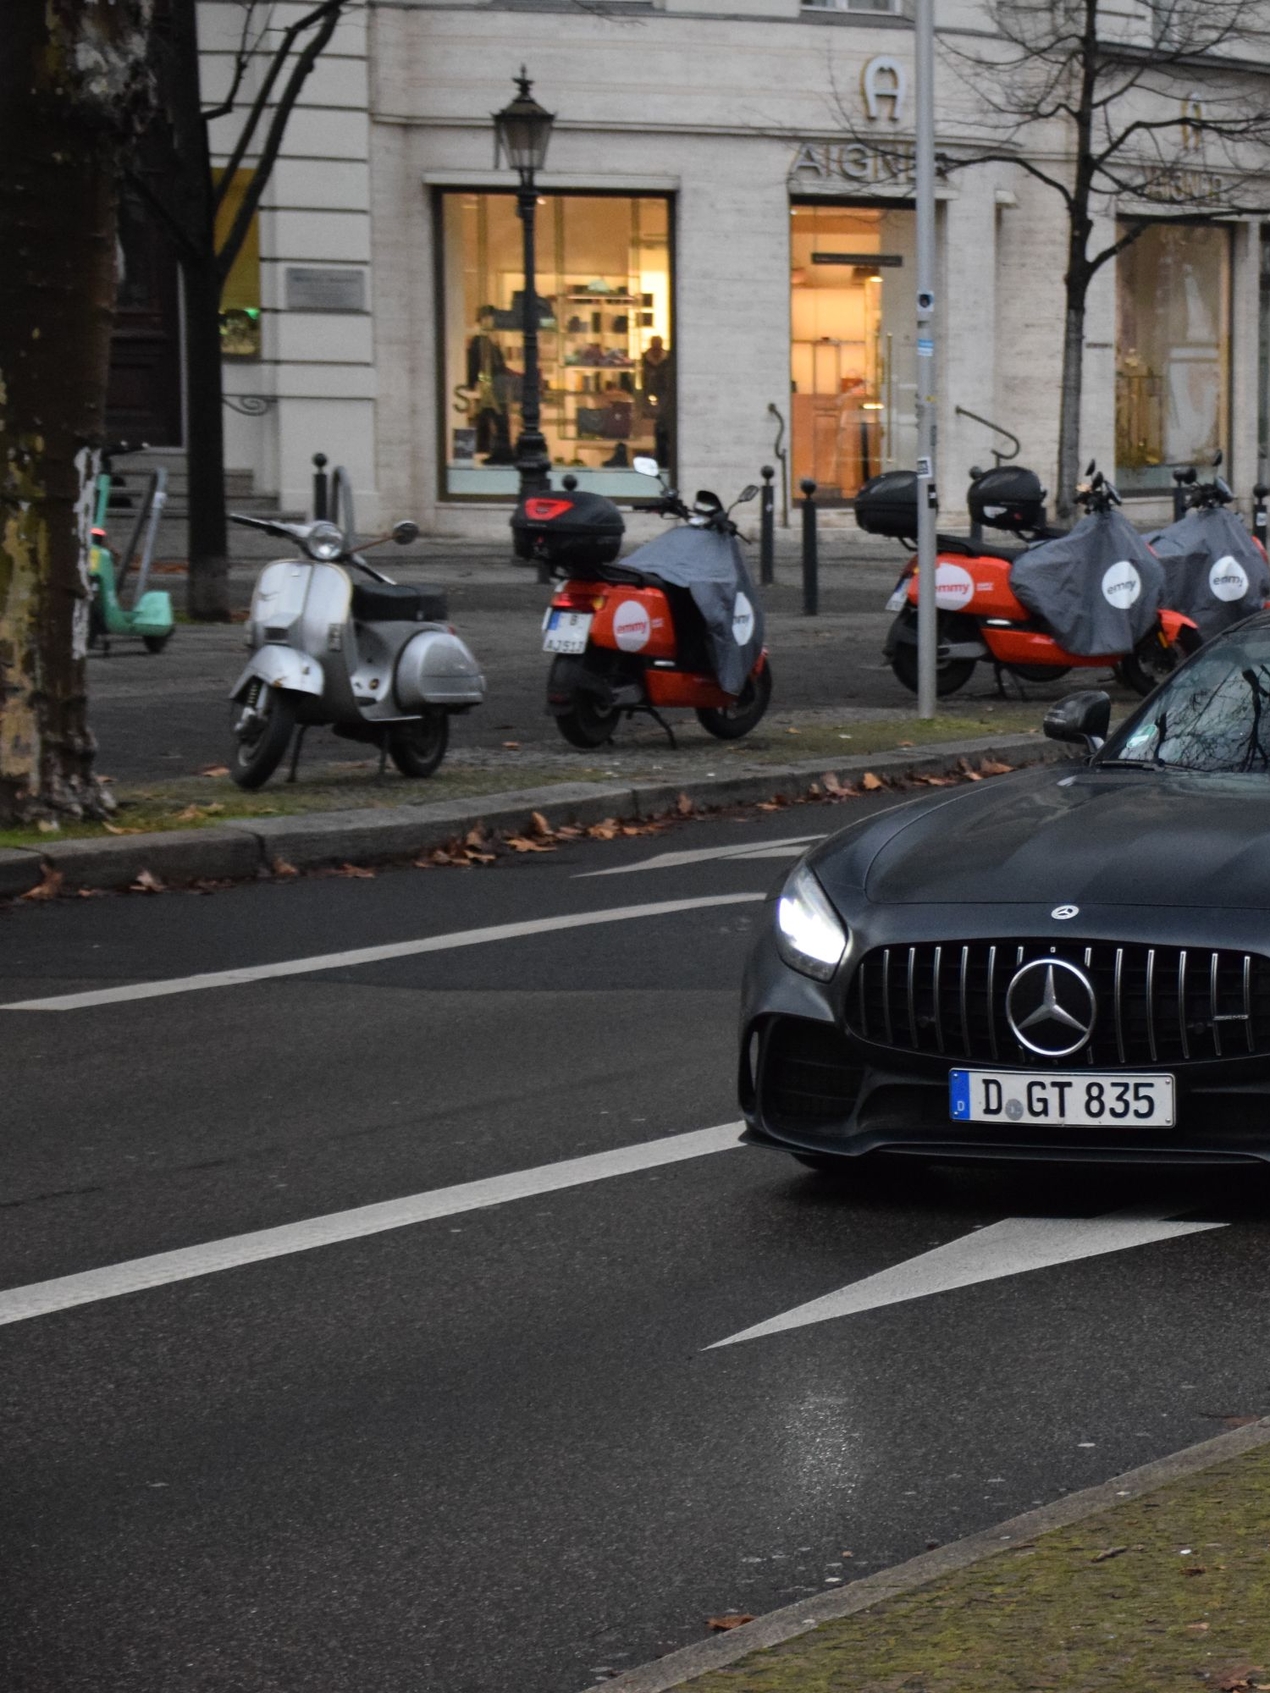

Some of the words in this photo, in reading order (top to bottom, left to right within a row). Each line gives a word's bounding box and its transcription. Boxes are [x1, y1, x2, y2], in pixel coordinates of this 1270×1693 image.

[957, 1101, 965, 1112] D
[982, 1079, 1003, 1115] D
[1027, 1081, 1073, 1118] GT
[1084, 1081, 1155, 1119] 835
